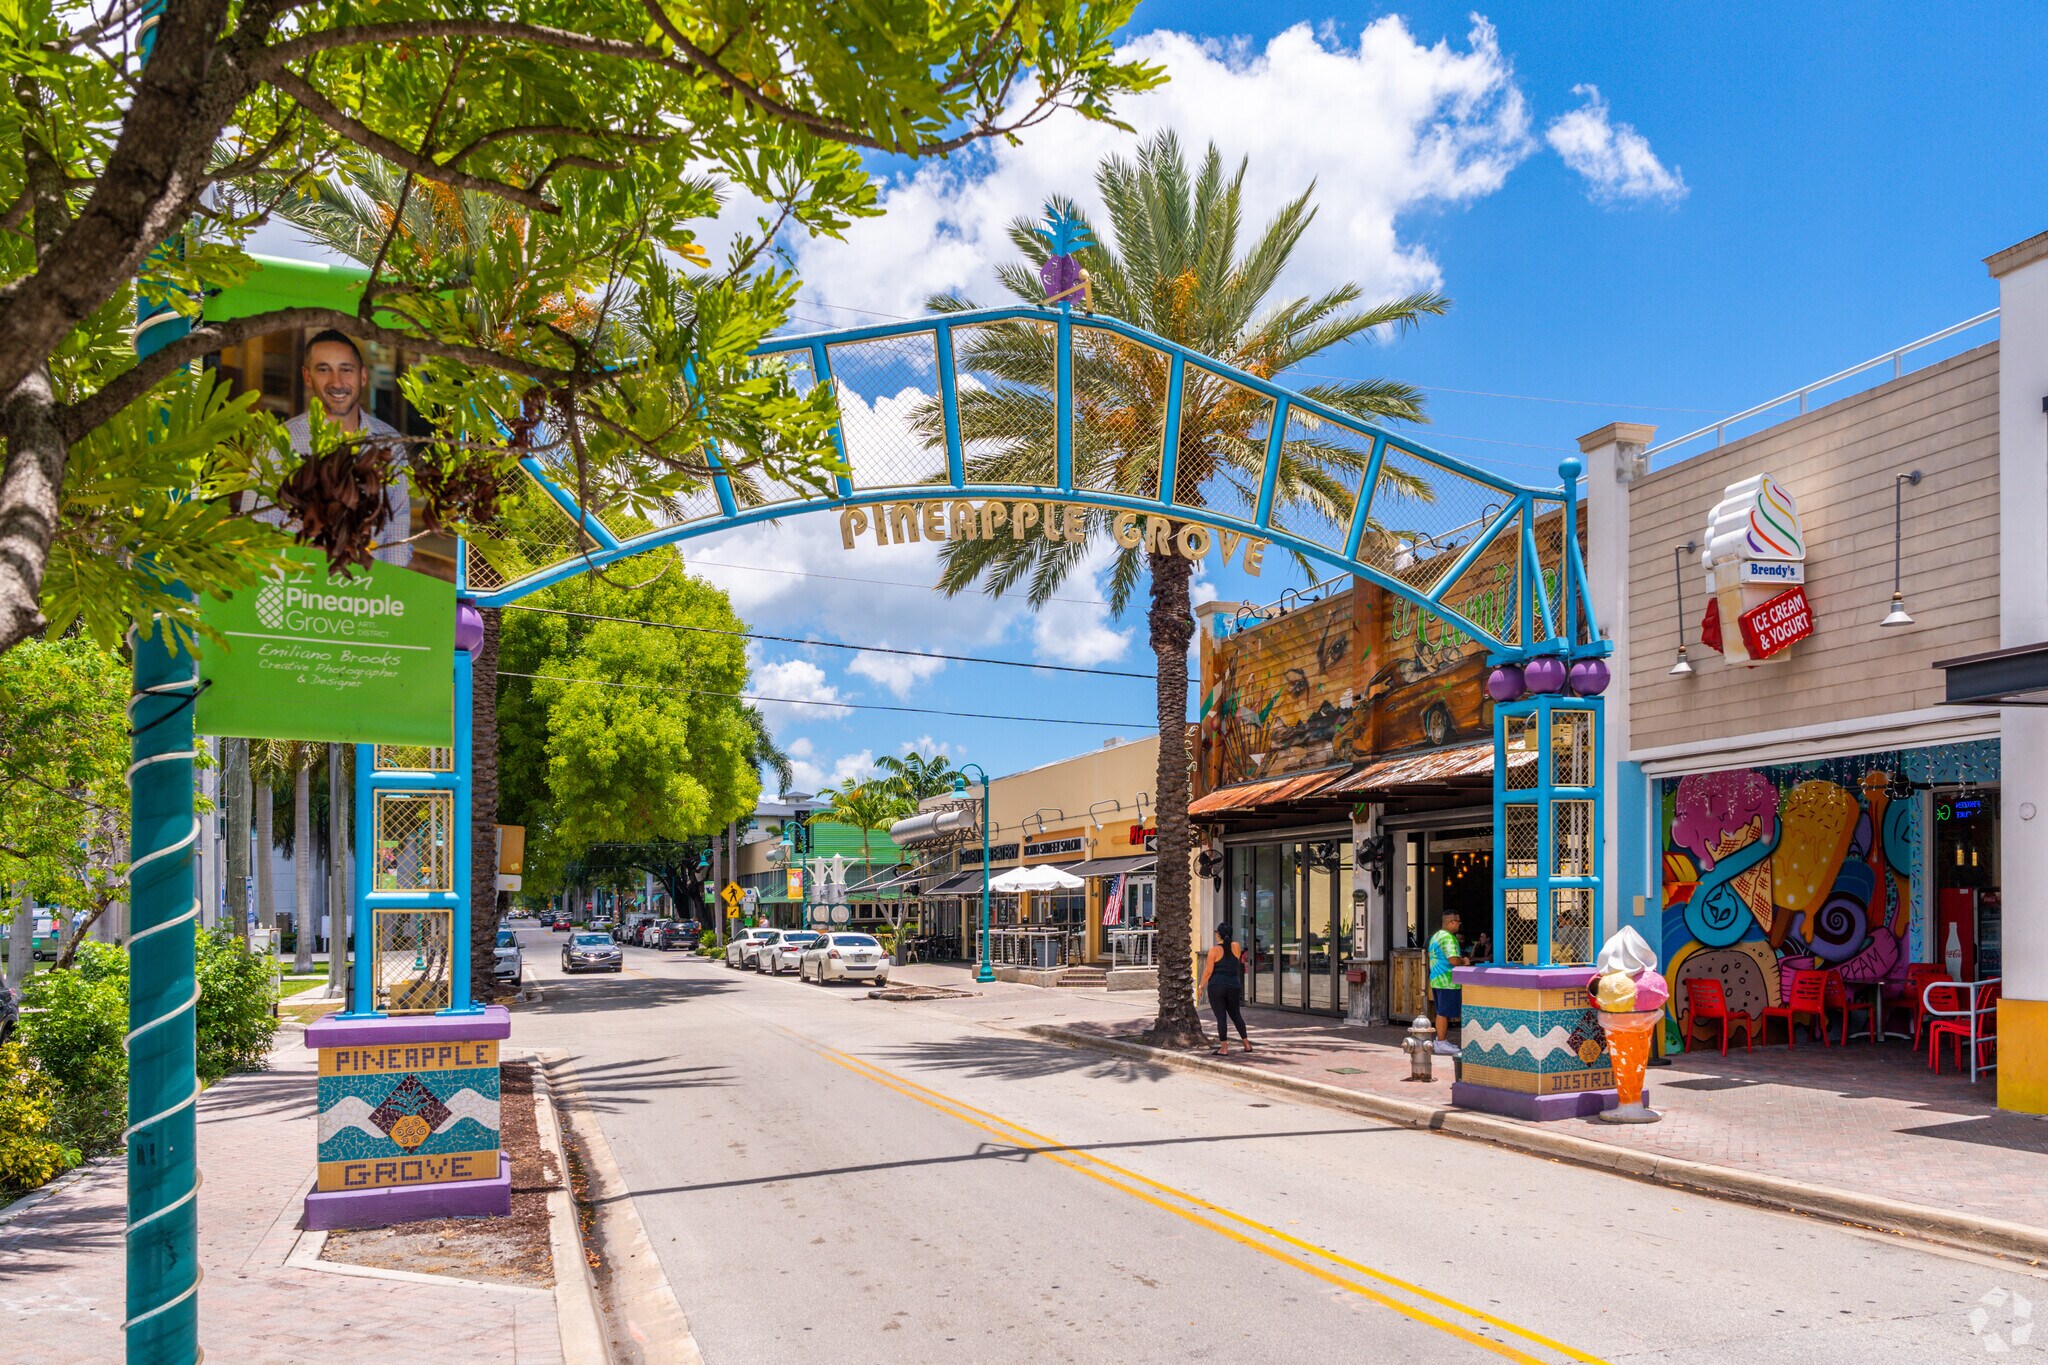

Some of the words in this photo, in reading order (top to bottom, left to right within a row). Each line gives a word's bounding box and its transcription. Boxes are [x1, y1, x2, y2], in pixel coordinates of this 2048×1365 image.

[839, 500, 1086, 550] PINEAPPLE
[1112, 509, 1272, 577] GROVE
[1750, 563, 1796, 579] Brendy's
[285, 587, 405, 619] Pineapple
[1751, 611, 1771, 634] ICE
[1769, 593, 1806, 624] CREAM
[285, 610, 355, 636] Grove
[357, 630, 391, 639] DISTRICT
[1759, 633, 1771, 651] &
[1768, 611, 1810, 645] YOGURT
[258, 643, 332, 661] Emiliano
[339, 649, 402, 667] Brooks
[259, 659, 310, 672] Creative
[315, 662, 400, 681] Photographer
[296, 673, 306, 684] &
[309, 673, 363, 692] Designer
[993, 843, 1019, 861] EATERY
[1563, 991, 1590, 1007] AR
[336, 1044, 489, 1072] PINEAPPLE
[1552, 1071, 1616, 1091] DISTRI
[344, 1156, 473, 1186] GROVE
